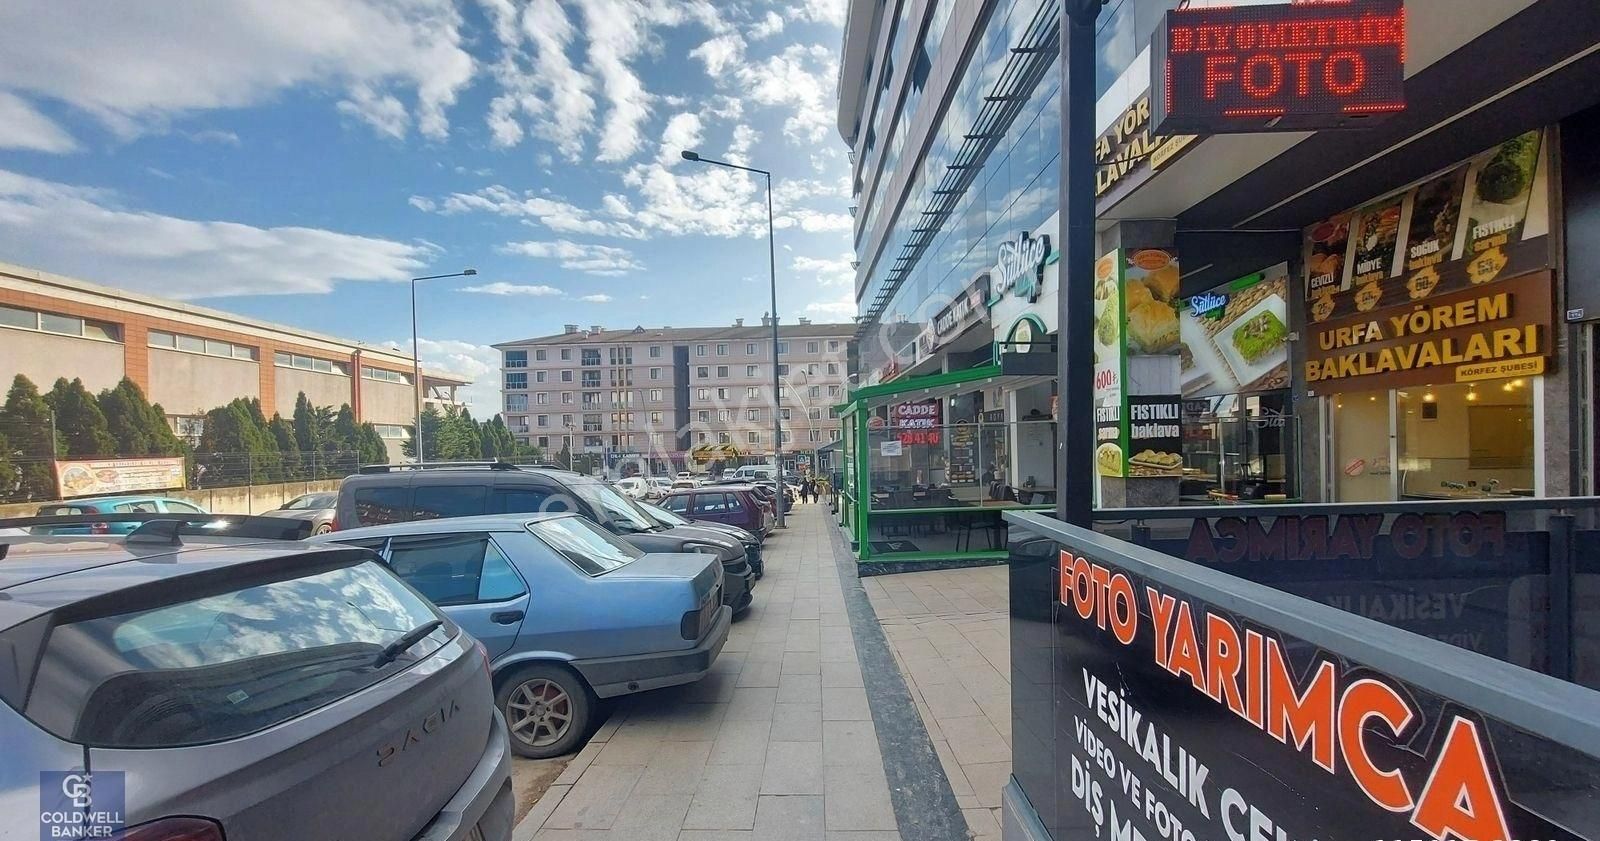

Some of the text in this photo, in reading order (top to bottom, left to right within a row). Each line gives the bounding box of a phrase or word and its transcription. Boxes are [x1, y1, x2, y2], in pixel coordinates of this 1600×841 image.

[1206, 51, 1366, 98] FOTO
[996, 231, 1045, 295] Sütlüce
[1319, 292, 1508, 350] URFA YÖREM
[1305, 324, 1538, 382] BAKLAVALARI
[1461, 360, 1538, 377] KÖRFEZ ŞUBESİ
[898, 404, 936, 416] CADDE
[1097, 405, 1120, 422] FISTIKLI
[1131, 403, 1179, 420] FISTIKLI
[1131, 422, 1181, 439] baklava
[1060, 549, 1138, 645] FOTO
[1146, 585, 1512, 841] YARIMCA
[1074, 715, 1116, 779] VİDEO
[1119, 761, 1141, 810] VE
[1082, 667, 1211, 820] VESİKALIK
[1071, 753, 1105, 838] DİŞ
